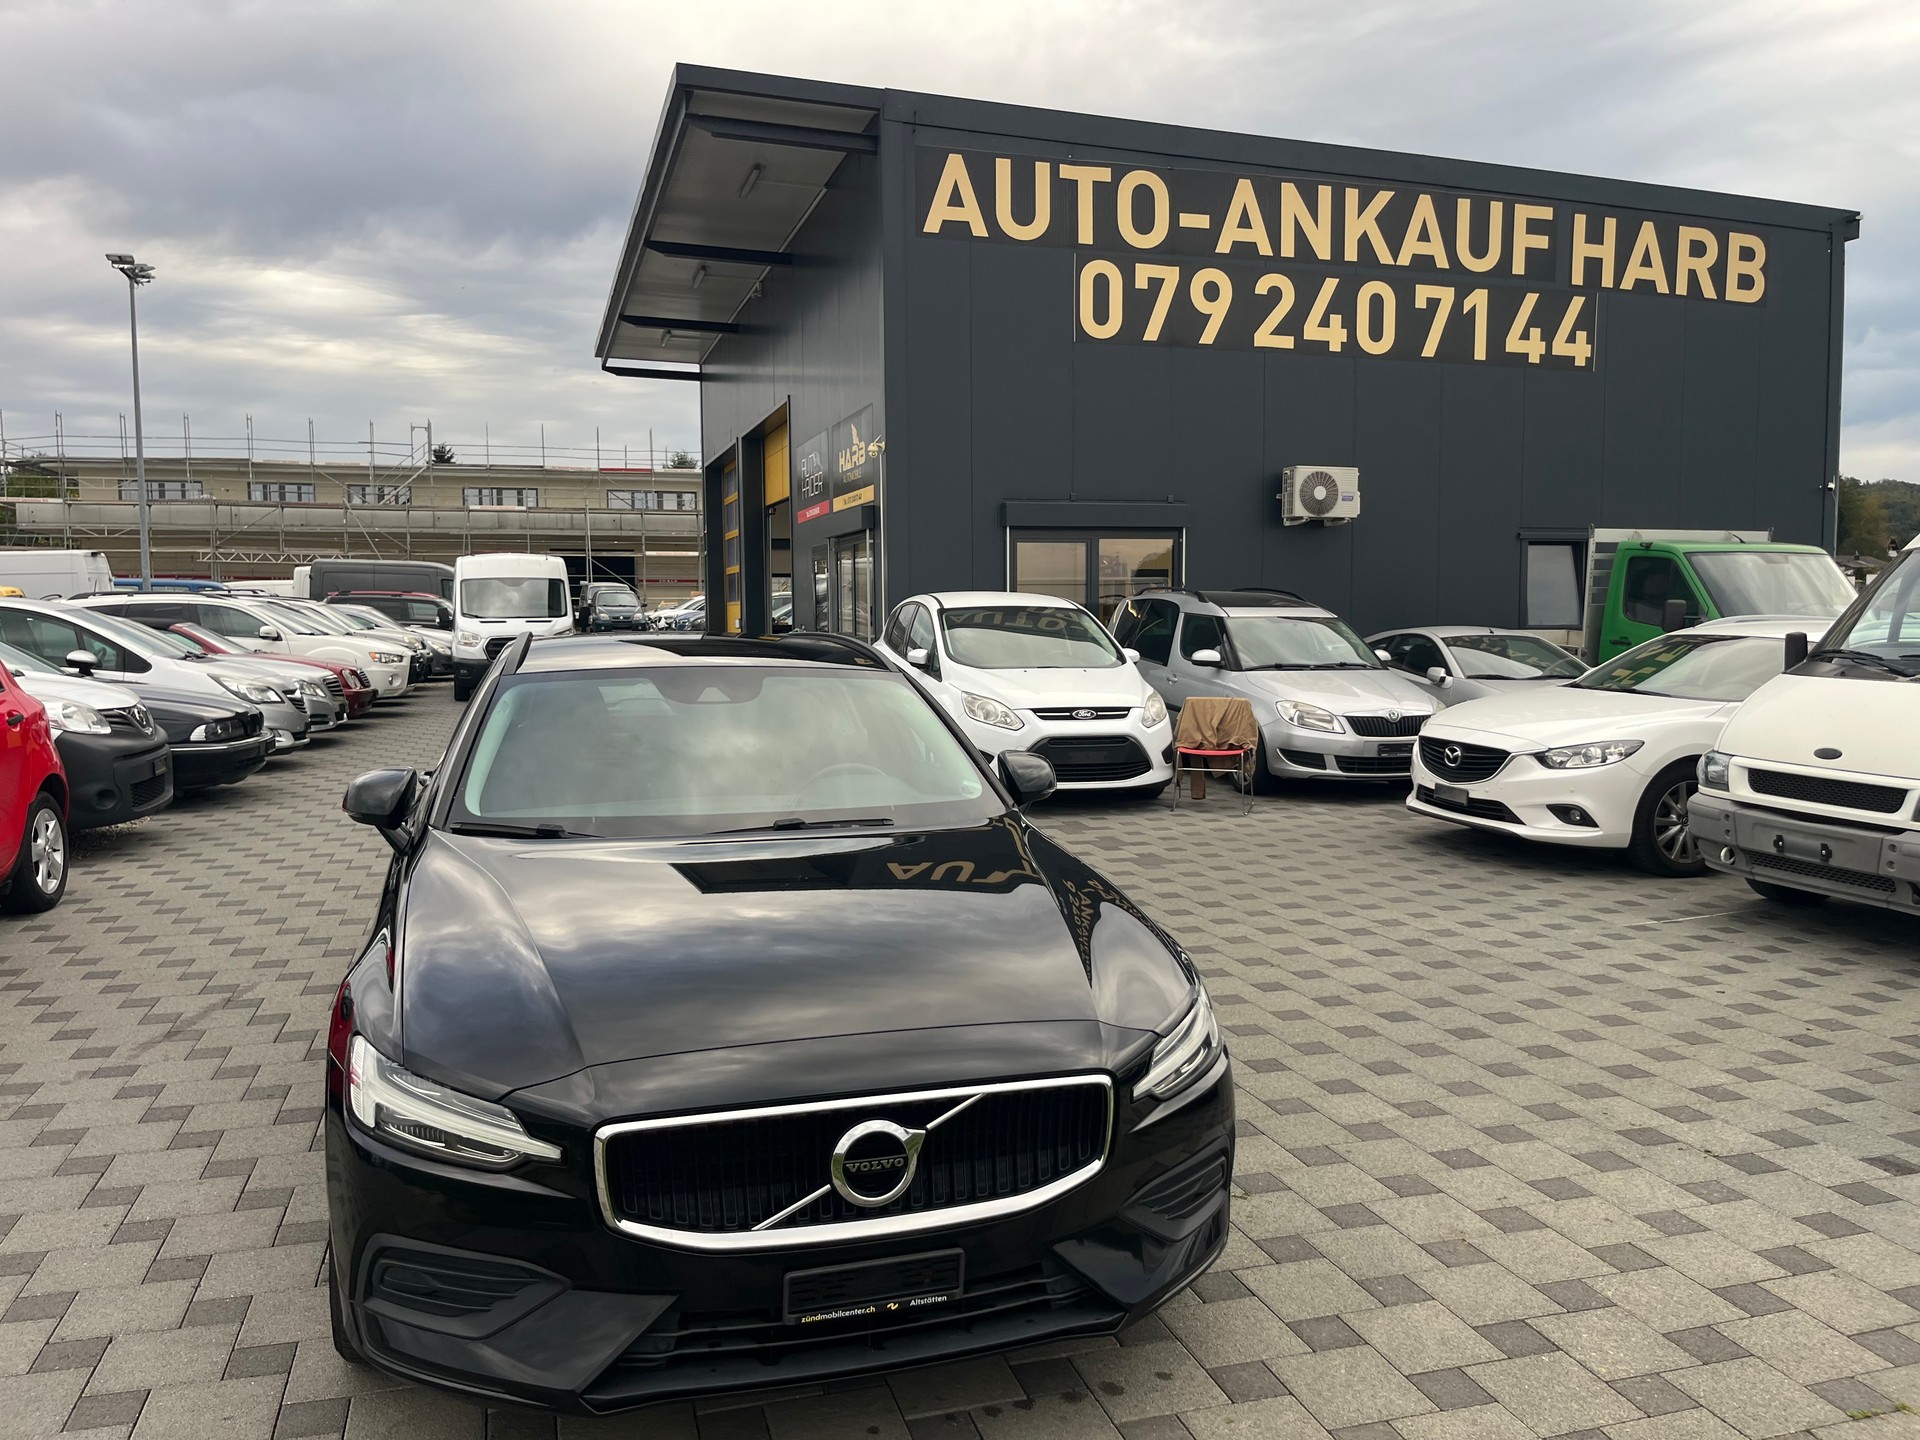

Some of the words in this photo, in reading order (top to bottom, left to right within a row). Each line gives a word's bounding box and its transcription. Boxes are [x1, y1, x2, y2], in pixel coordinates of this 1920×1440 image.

[924, 153, 1553, 275] AUTO-ANKAUF
[1571, 214, 1766, 303] HARB
[1079, 259, 1233, 345] 079
[1253, 273, 1396, 355] 240
[838, 441, 866, 473] HARB
[845, 1157, 905, 1173] VOLVO
[801, 1305, 876, 1323] zündmobilcenter.ch
[909, 1295, 948, 1307] Altstätten
